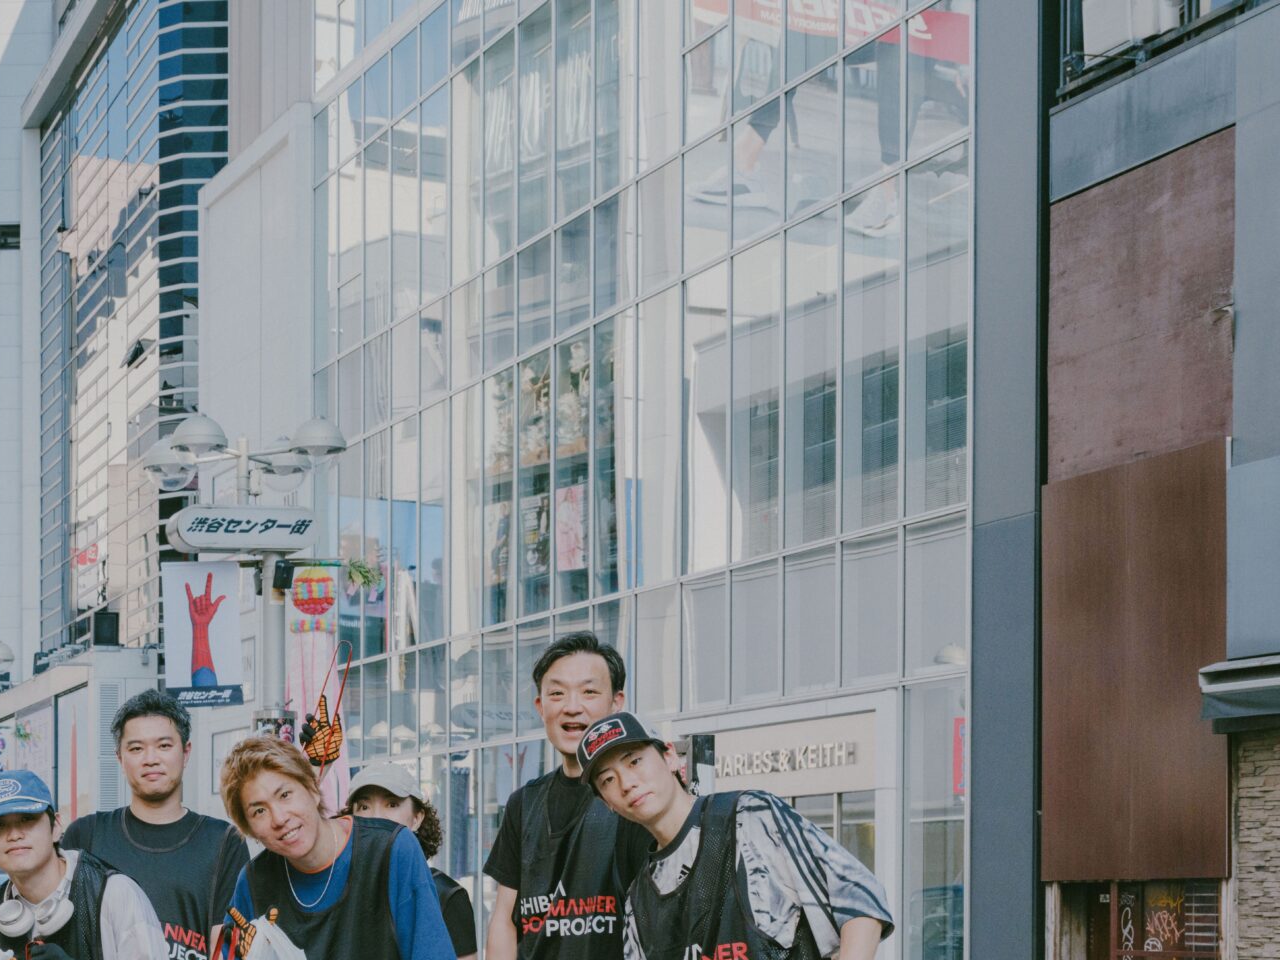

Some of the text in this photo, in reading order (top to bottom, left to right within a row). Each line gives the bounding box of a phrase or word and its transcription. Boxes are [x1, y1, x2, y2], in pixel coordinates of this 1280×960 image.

[186, 517, 313, 535] 渋谷センター街
[778, 748, 791, 773] &
[795, 741, 847, 771] KEITH
